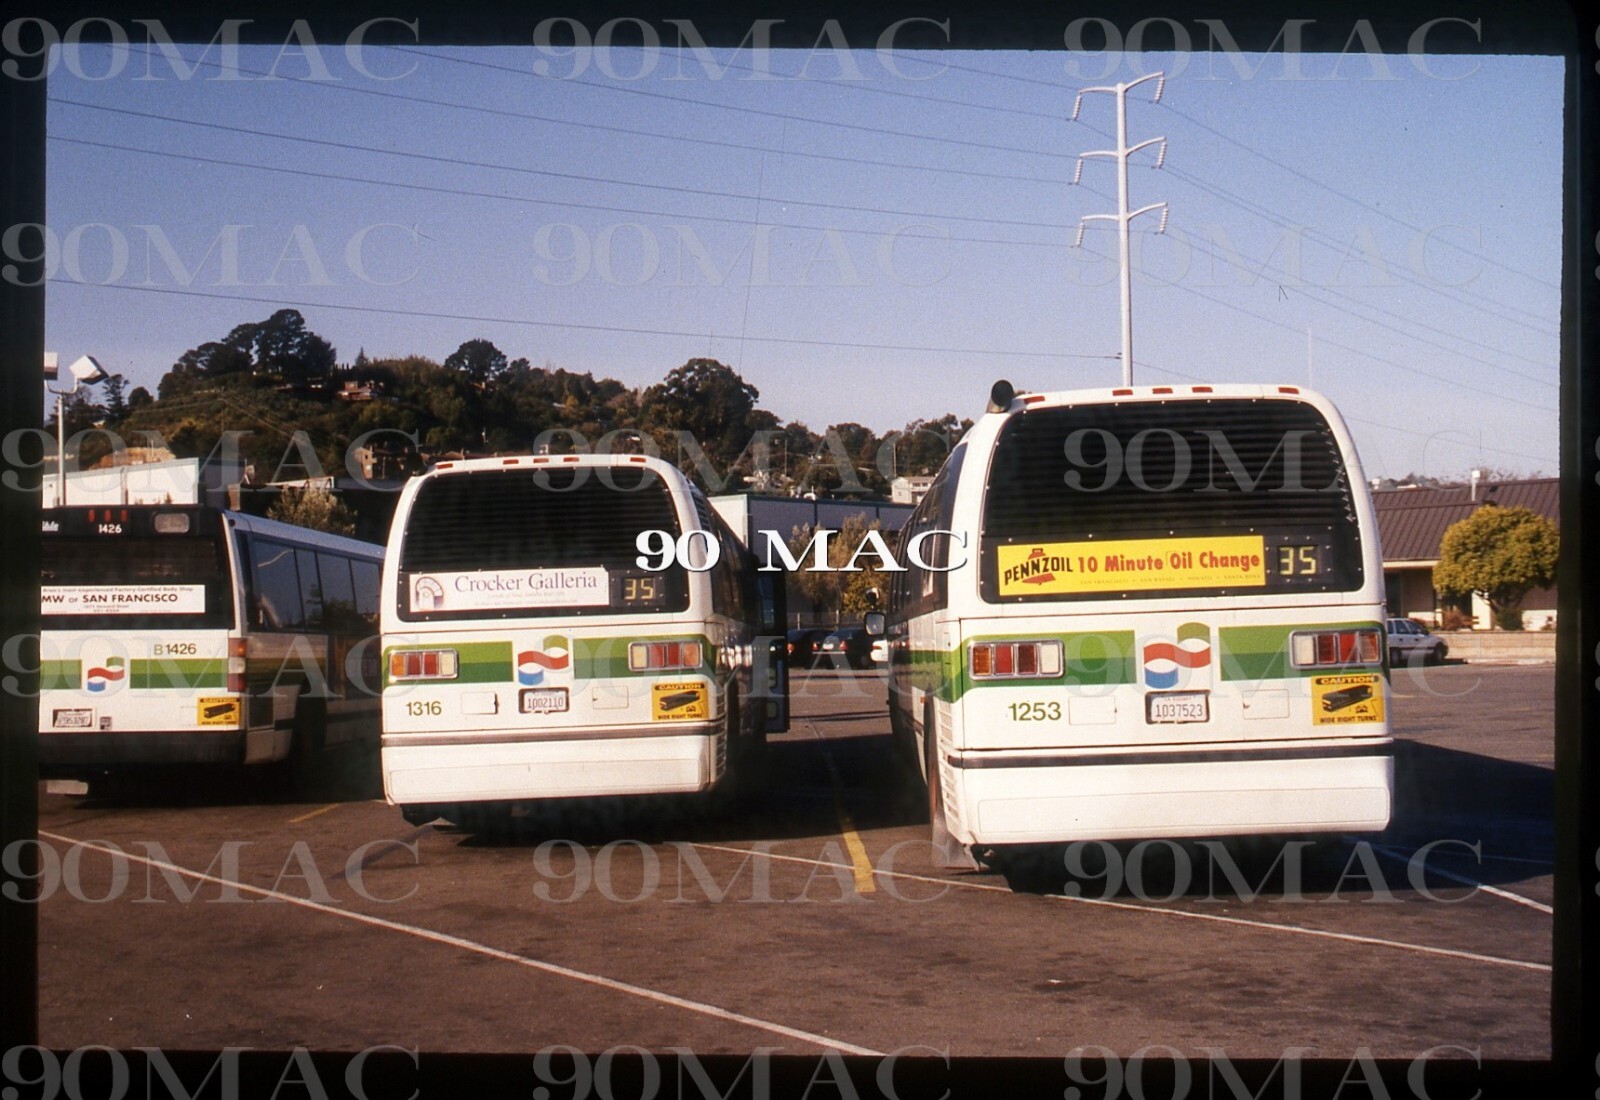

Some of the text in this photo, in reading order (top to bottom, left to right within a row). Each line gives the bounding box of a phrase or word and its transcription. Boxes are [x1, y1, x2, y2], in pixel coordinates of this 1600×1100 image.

[98, 524, 122, 534] 1426
[1004, 551, 1260, 586] PENNZOIL 10 Minute Oil Change
[1280, 546, 1317, 575] 35
[454, 571, 598, 593] Crocker Galleria
[624, 577, 655, 600] 35
[82, 594, 108, 603] SAN
[111, 593, 178, 603] FRANCISCO
[1320, 676, 1374, 684] CAUTION
[405, 700, 442, 716] 1316
[528, 697, 564, 709] 1002110
[1156, 703, 1203, 717] 1037523
[1007, 702, 1061, 721] 1253
